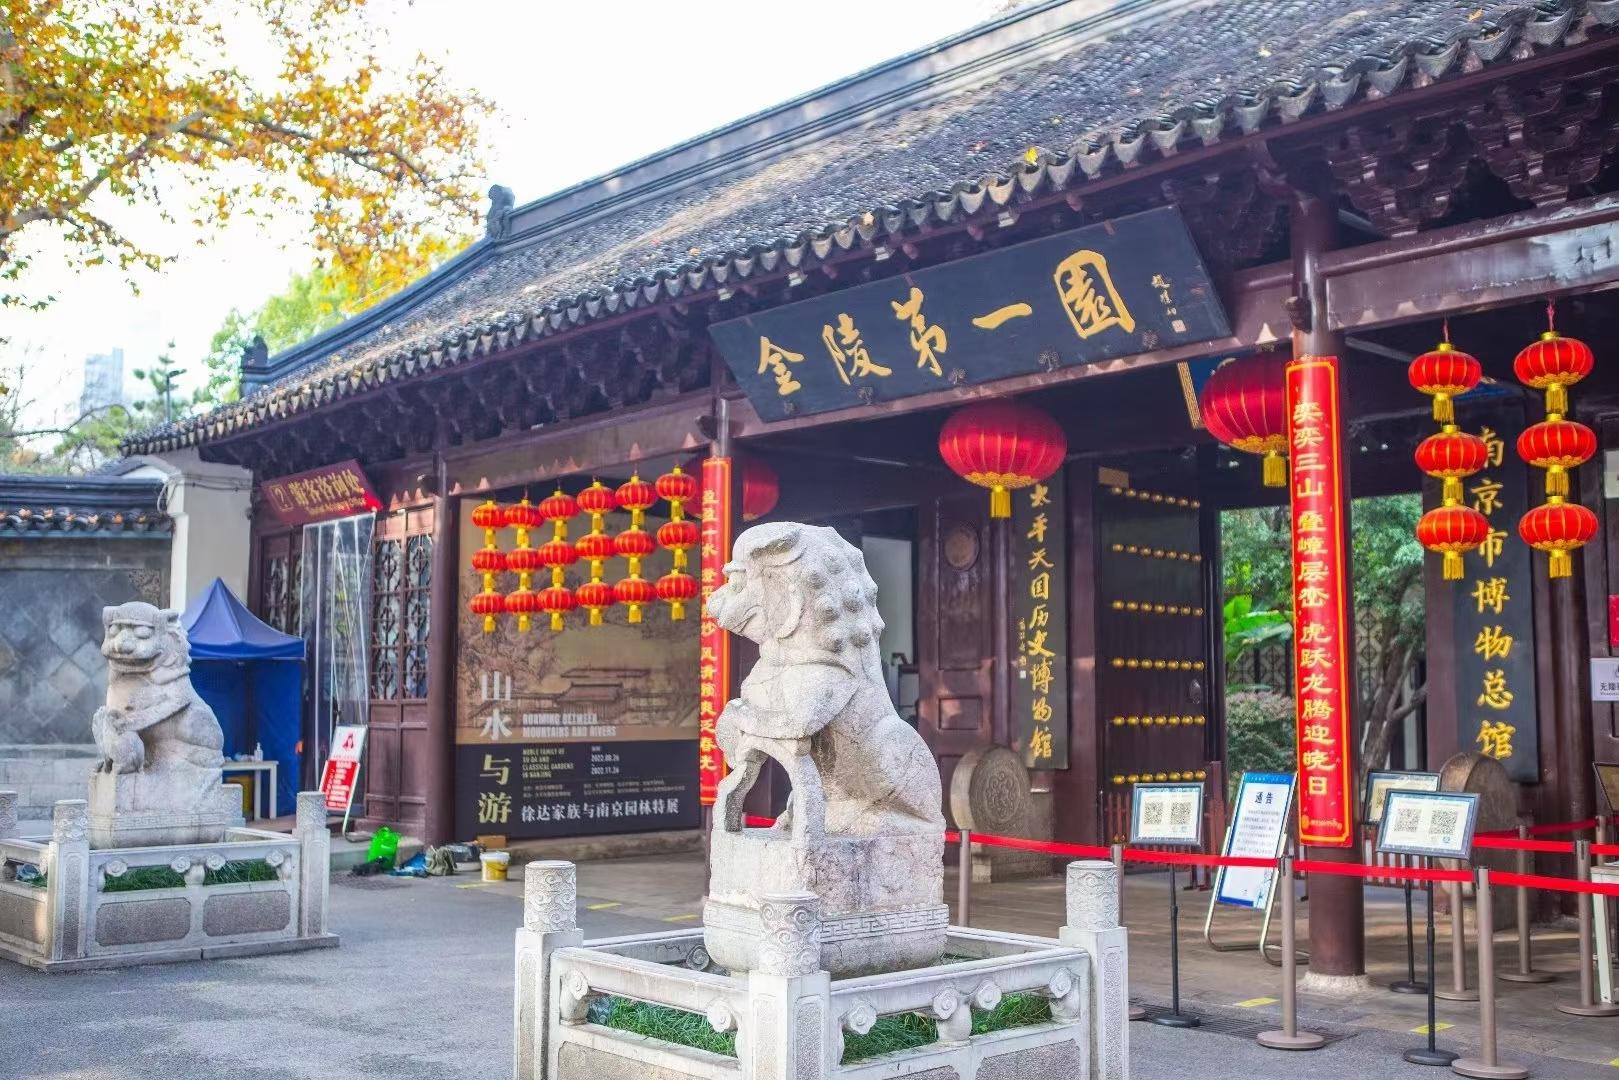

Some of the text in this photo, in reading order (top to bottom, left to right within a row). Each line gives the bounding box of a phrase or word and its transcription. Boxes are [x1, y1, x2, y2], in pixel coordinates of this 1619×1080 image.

[1471, 426, 1516, 760] 南京市博物总馆
[562, 712, 598, 725] BETWEEN
[522, 725, 617, 738] MOUNTAINS AND RIVERS
[521, 798, 679, 823] 徐达家族与南京园林特展
